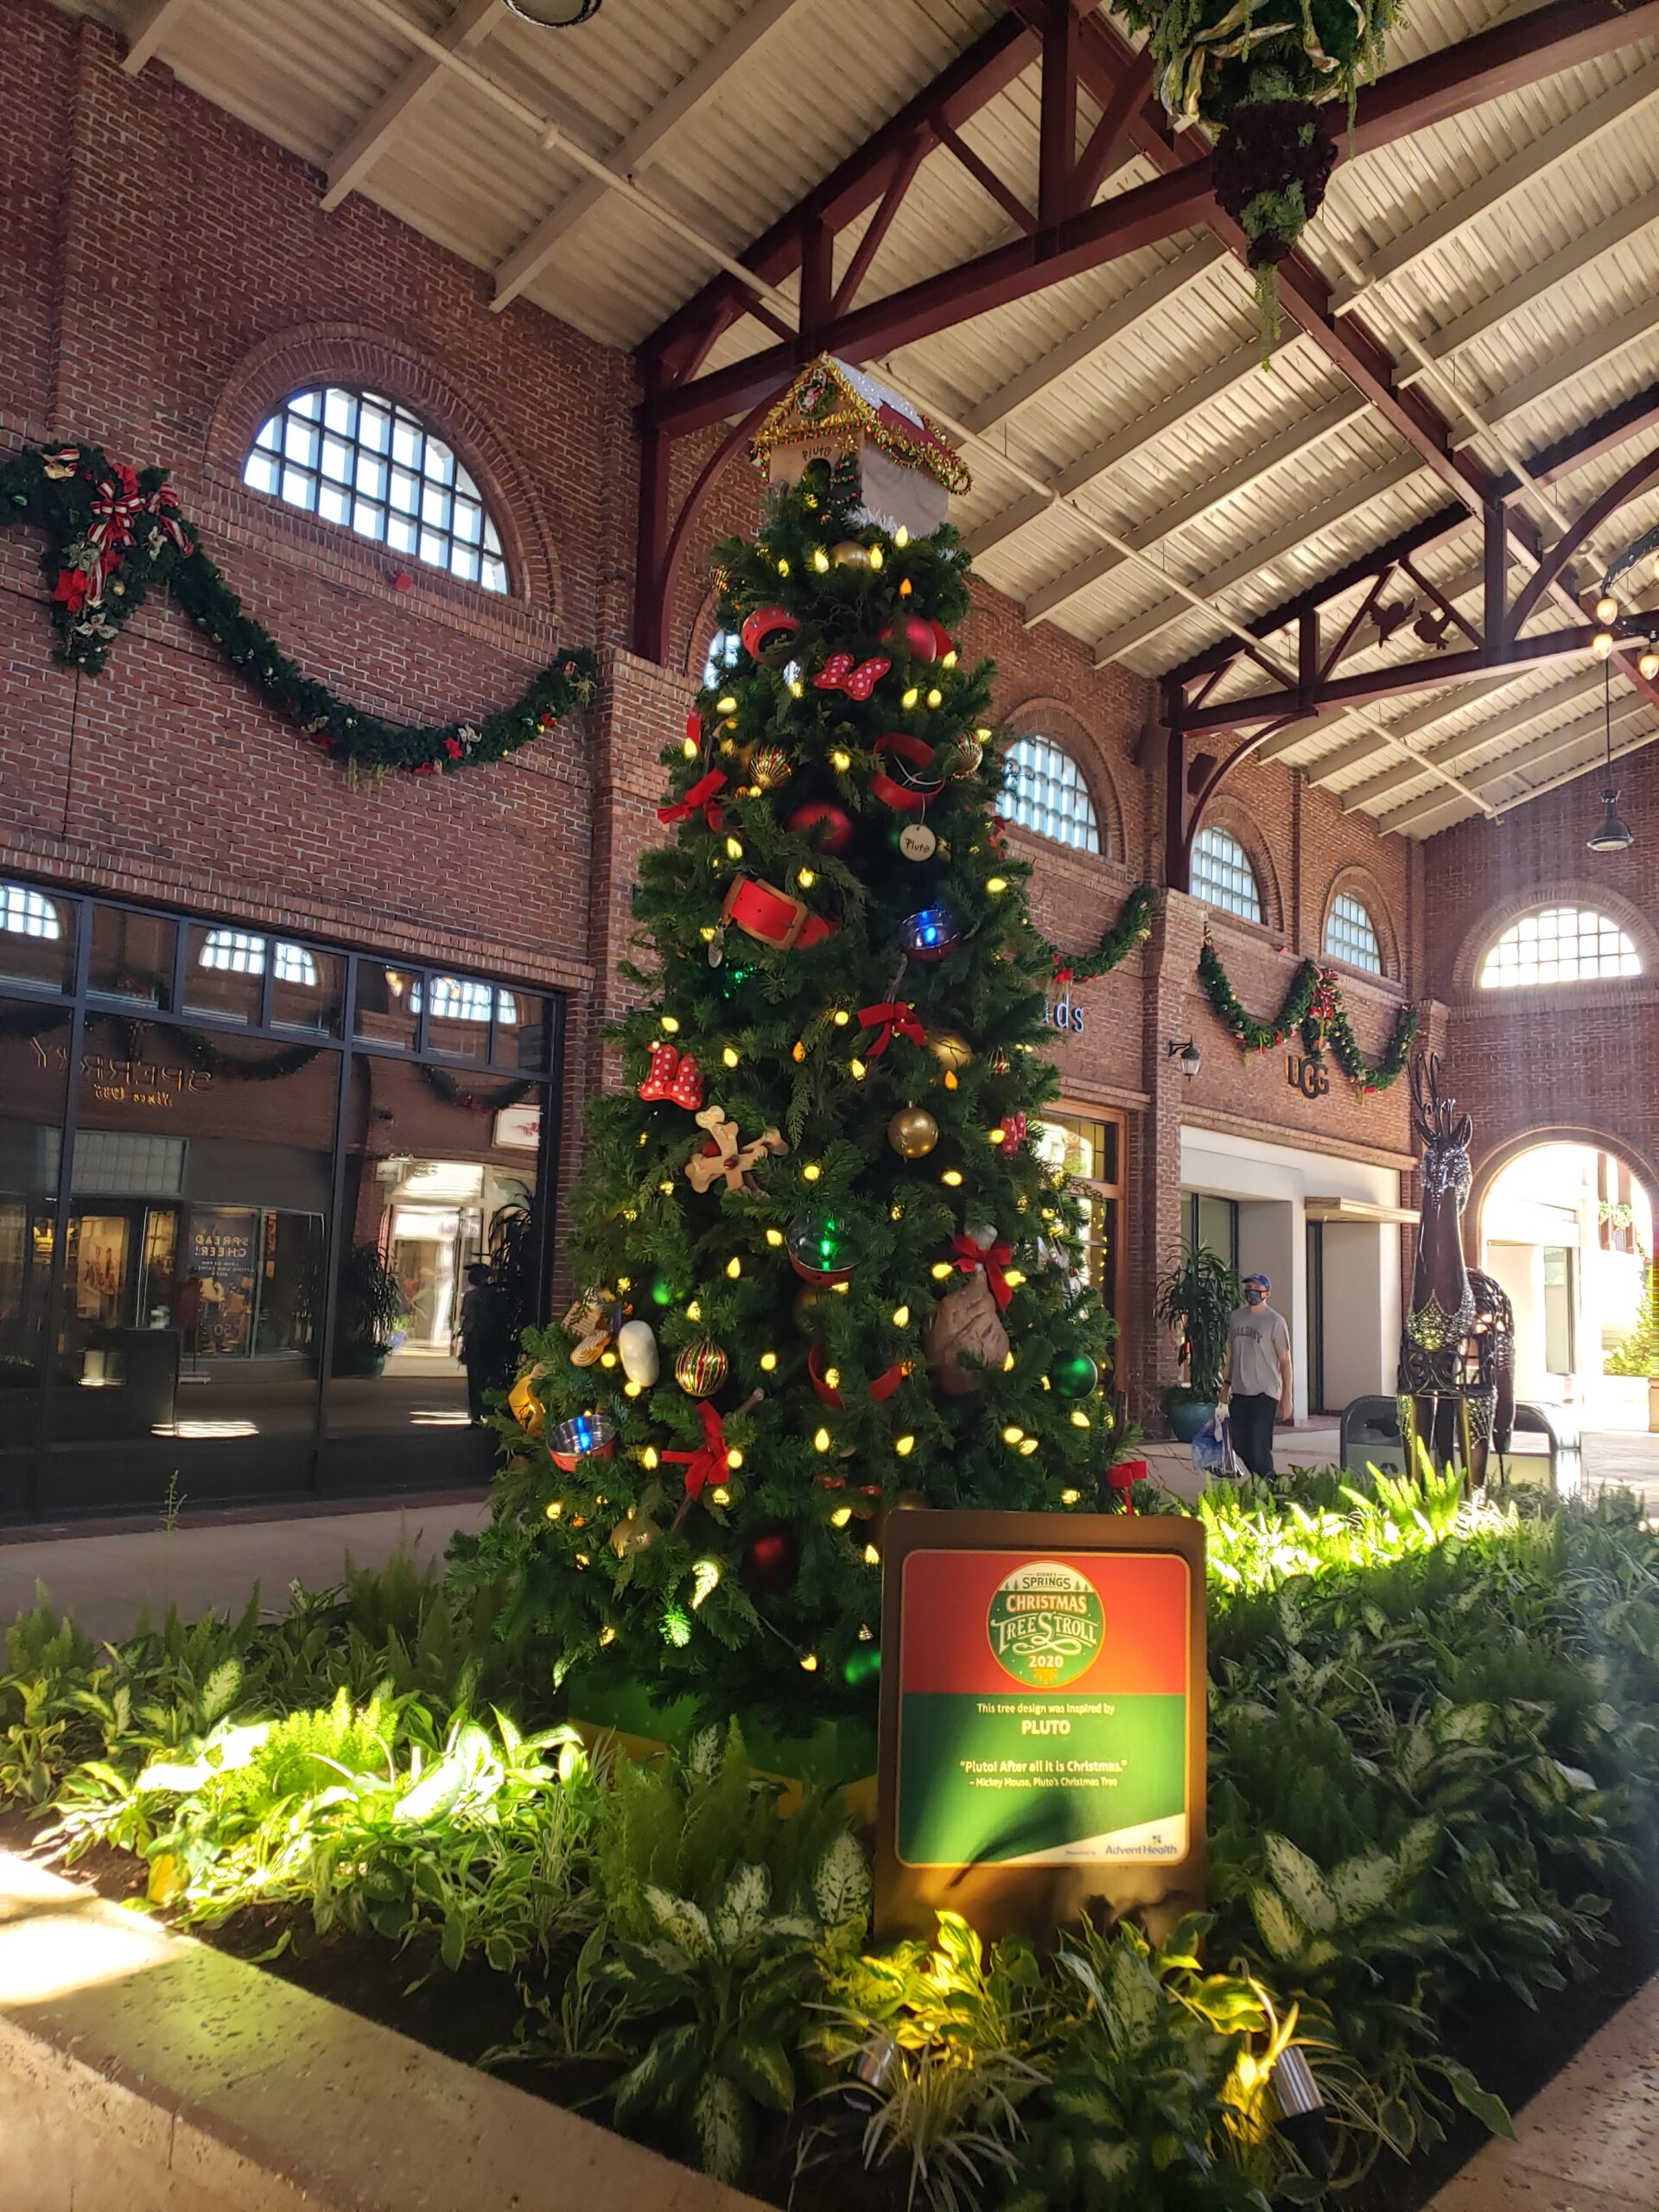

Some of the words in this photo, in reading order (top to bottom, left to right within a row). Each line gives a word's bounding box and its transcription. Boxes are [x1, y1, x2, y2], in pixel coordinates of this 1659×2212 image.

[1287, 1055, 1329, 1099] UGG
[1022, 1577, 1071, 1590] SPRINGS
[1007, 1594, 1087, 1613] CHRISTMAS
[1029, 1655, 1064, 1668] 2020
[976, 1703, 995, 1713] This
[997, 1704, 1016, 1713] tree
[1017, 1703, 1046, 1715] design
[1048, 1705, 1065, 1713] was
[1067, 1703, 1102, 1715] inspired
[1103, 1703, 1115, 1716] by
[1021, 1719, 1071, 1735] PLUTO
[999, 1760, 1027, 1773] After
[1029, 1760, 1043, 1773] all
[1045, 1760, 1053, 1772] it
[1056, 1760, 1065, 1772] is
[976, 1777, 1003, 1789] Mickey
[1060, 1777, 1099, 1788] Christmas
[1100, 1777, 1118, 1788] Tree
[1105, 1845, 1178, 1855] AdventHealth
